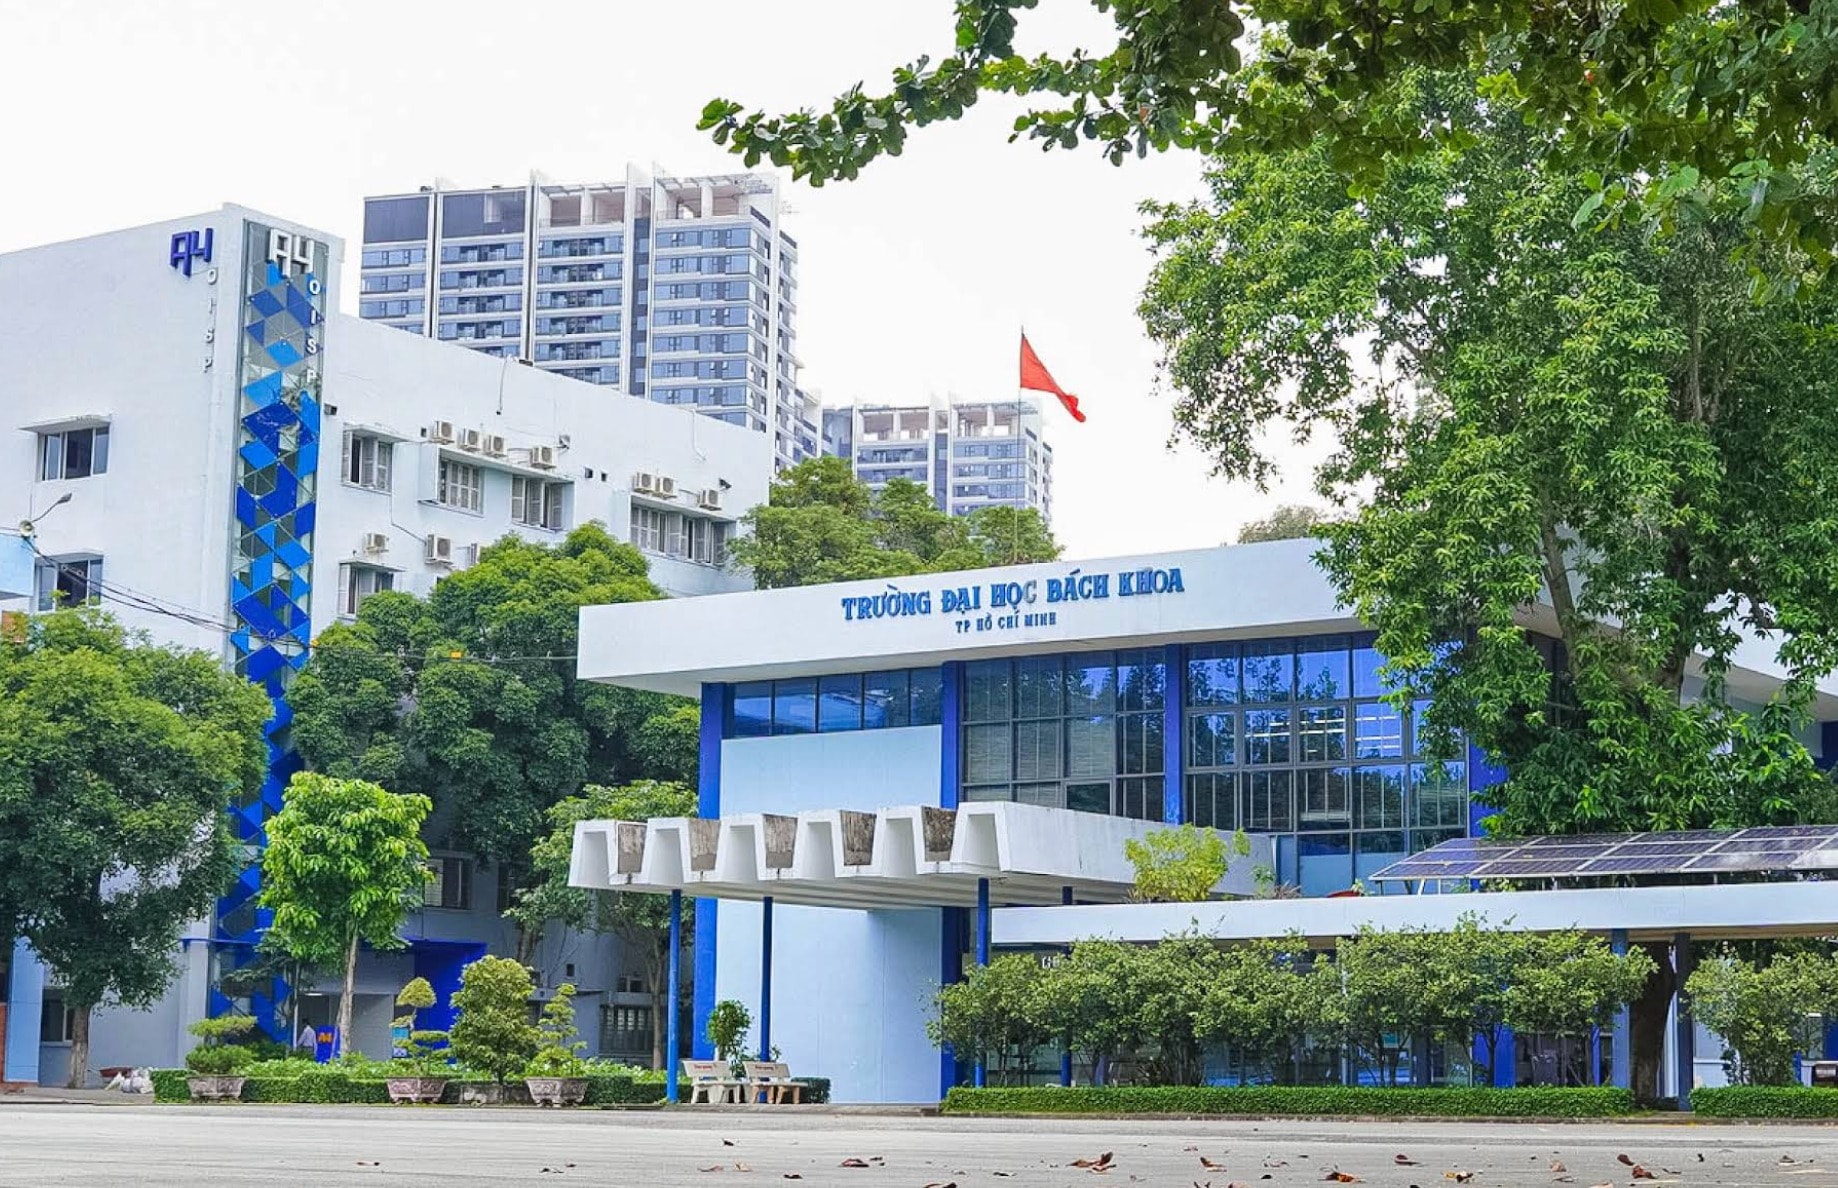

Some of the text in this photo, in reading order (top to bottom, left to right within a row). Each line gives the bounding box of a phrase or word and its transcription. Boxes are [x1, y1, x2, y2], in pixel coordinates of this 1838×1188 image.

[170, 228, 213, 277] A4
[269, 229, 315, 277] A4
[306, 279, 321, 383] OISP
[841, 567, 1185, 620] TRƯỜNG ĐẠI HỌC BÁCH KHOA
[955, 619, 971, 633] TP
[998, 610, 1020, 629] CHÍ
[1024, 612, 1057, 627] MINH
